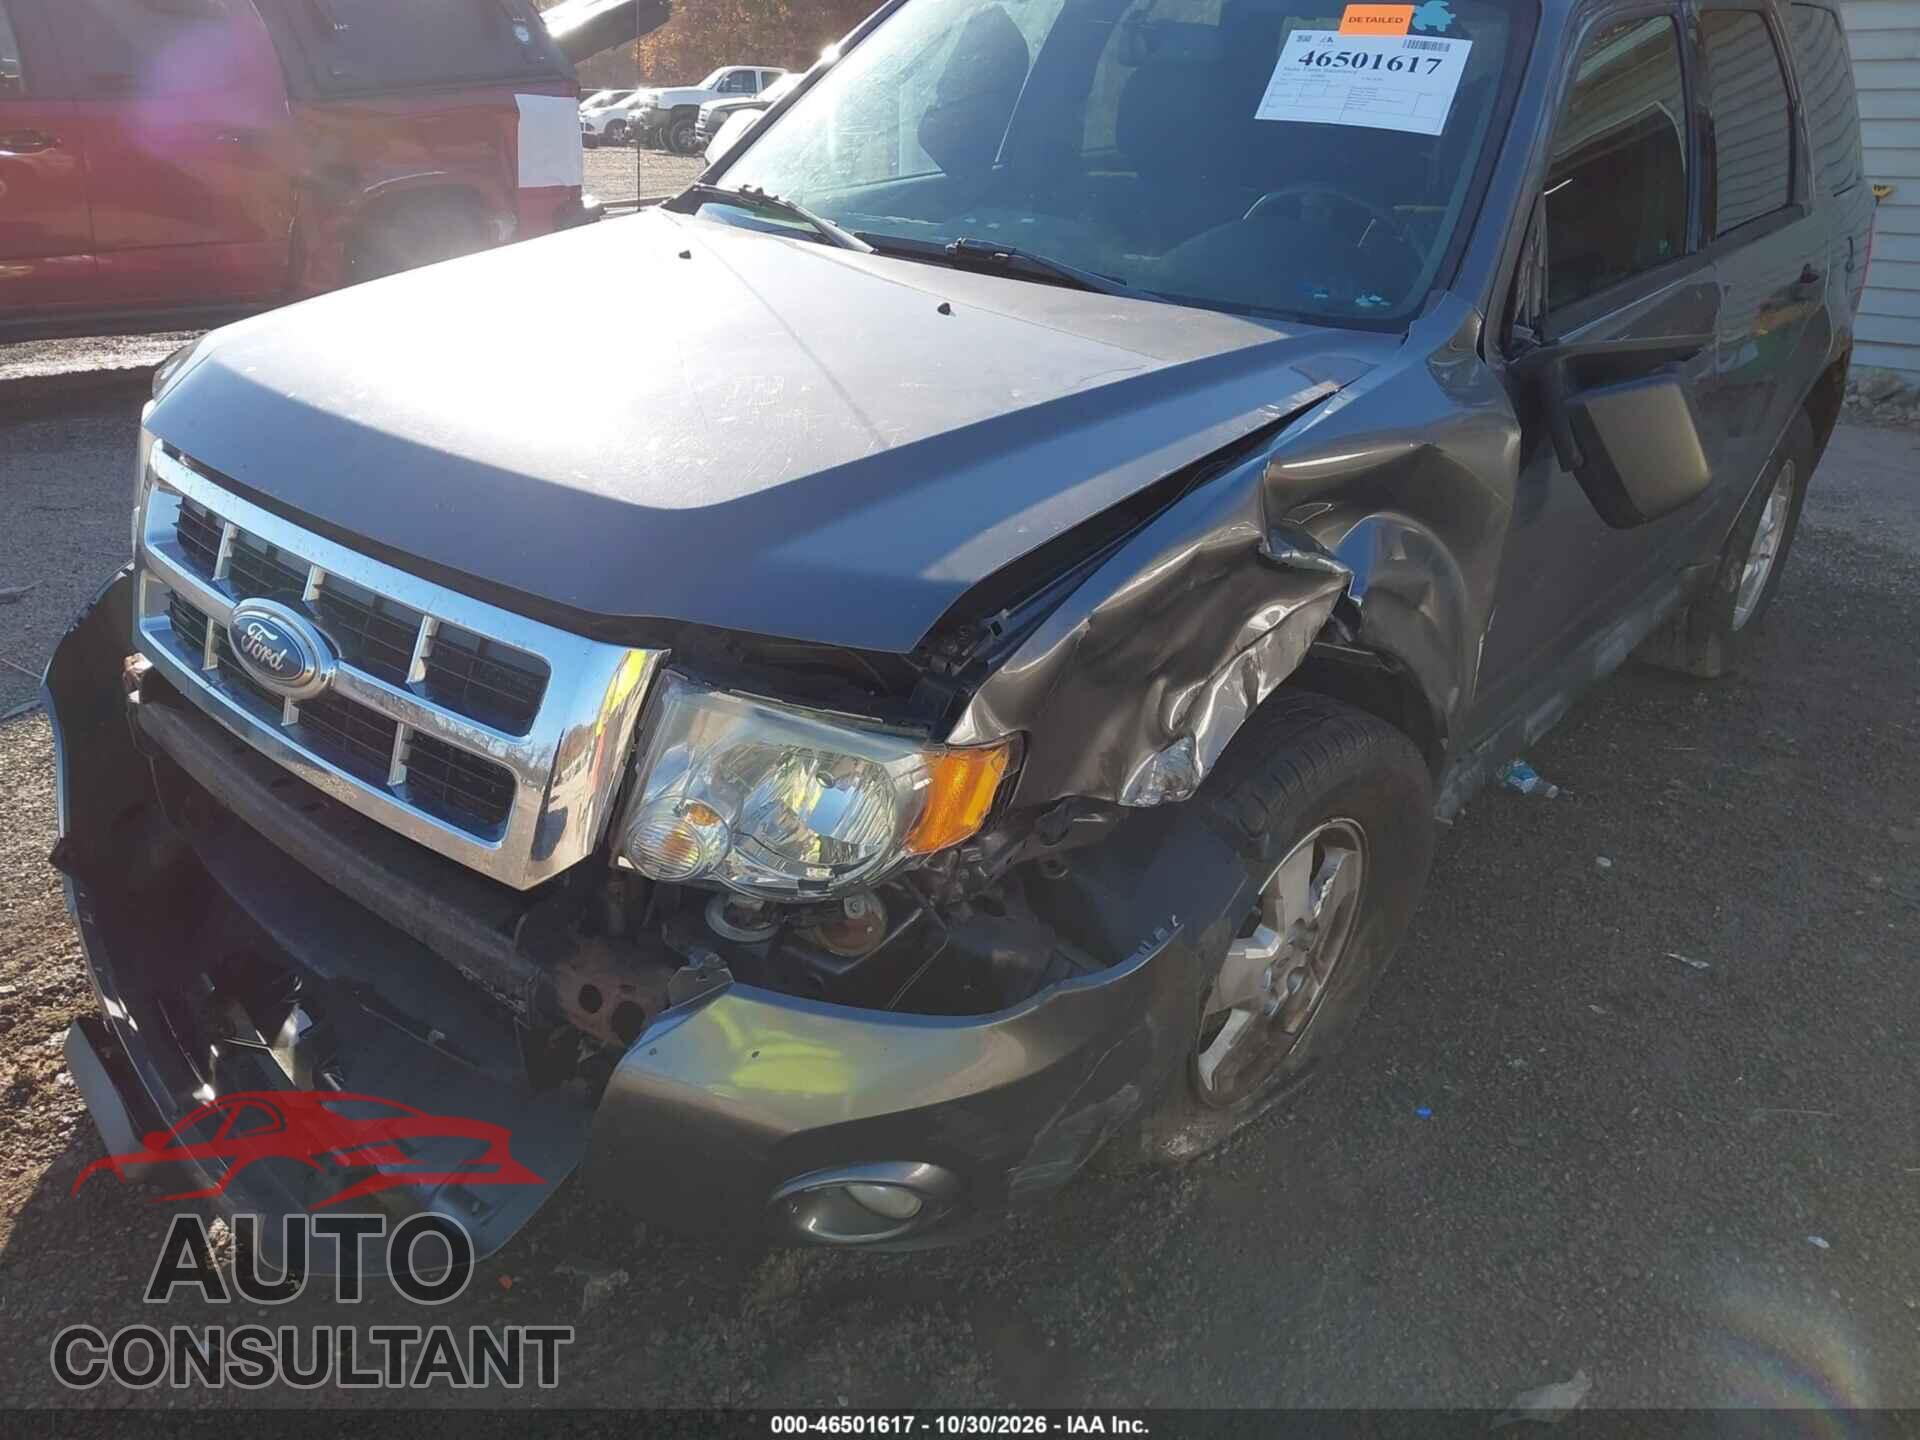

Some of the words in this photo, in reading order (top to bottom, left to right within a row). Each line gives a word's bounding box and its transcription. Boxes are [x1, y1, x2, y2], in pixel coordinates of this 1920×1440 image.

[1348, 16, 1404, 24] DETAILED
[1298, 50, 1442, 74] 46501617
[241, 622, 288, 671] Ford
